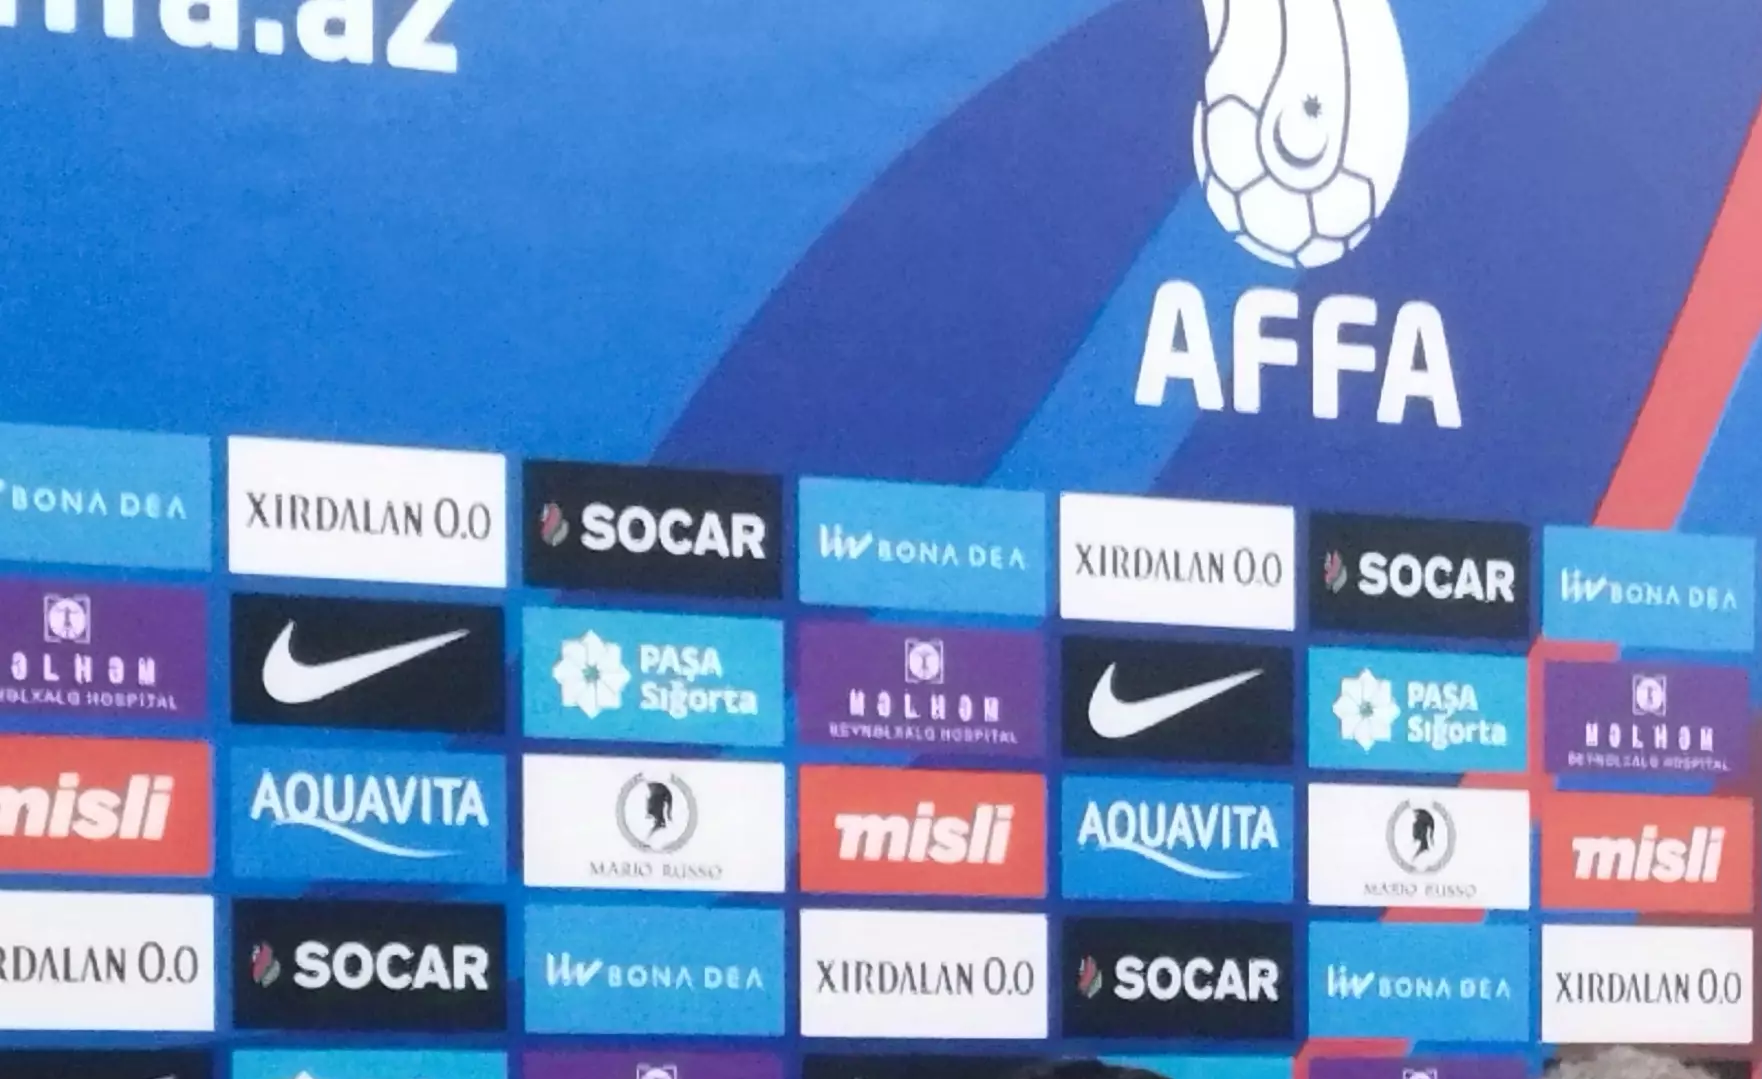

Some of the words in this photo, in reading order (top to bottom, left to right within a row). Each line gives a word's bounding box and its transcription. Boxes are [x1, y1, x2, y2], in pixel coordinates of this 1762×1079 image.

[1134, 279, 1462, 428] AFFA
[9, 486, 107, 518] BONA
[119, 493, 187, 523] DEA
[245, 491, 423, 538] XIRDALAN
[433, 497, 491, 542] 0.0
[580, 502, 766, 560] SOCAR
[878, 539, 959, 567] BONA
[969, 544, 1026, 571] DEA
[1075, 542, 1224, 583] XIRDALAN
[1233, 546, 1282, 587] 0.0
[1357, 550, 1515, 602] SOCAR
[1611, 582, 1680, 607] BONA
[1689, 586, 1737, 611] DEA
[11, 651, 156, 686] ƏLHƏM
[639, 644, 723, 683] PAŞA
[849, 689, 1000, 723] MƏLHƏM
[1406, 680, 1478, 716] PAŞA
[1586, 720, 1714, 751] MƏLHƏM
[0, 769, 174, 843] misli
[250, 770, 489, 828] AQUAVITA
[834, 798, 1014, 865] misli
[1078, 797, 1279, 850] AQUAVITA
[589, 860, 651, 877] MARIO
[662, 862, 723, 879] RUSSO
[1572, 822, 1726, 882] misli
[1363, 880, 1416, 895] MARIO
[1425, 881, 1477, 896] RUSSO
[0, 944, 125, 984] RDALAN
[136, 942, 198, 985] 0.0
[292, 940, 489, 991] SOCAR
[607, 964, 693, 989] BONA
[704, 965, 763, 990] DEA
[815, 958, 973, 994] XIRDALAN
[981, 956, 1034, 995] 0.0
[1112, 954, 1278, 1000] SOCAR
[1378, 975, 1452, 998] BONA
[1460, 976, 1511, 999] DEA
[1555, 970, 1690, 1002] XIRDALAN
[1697, 967, 1742, 1003] 0.0
